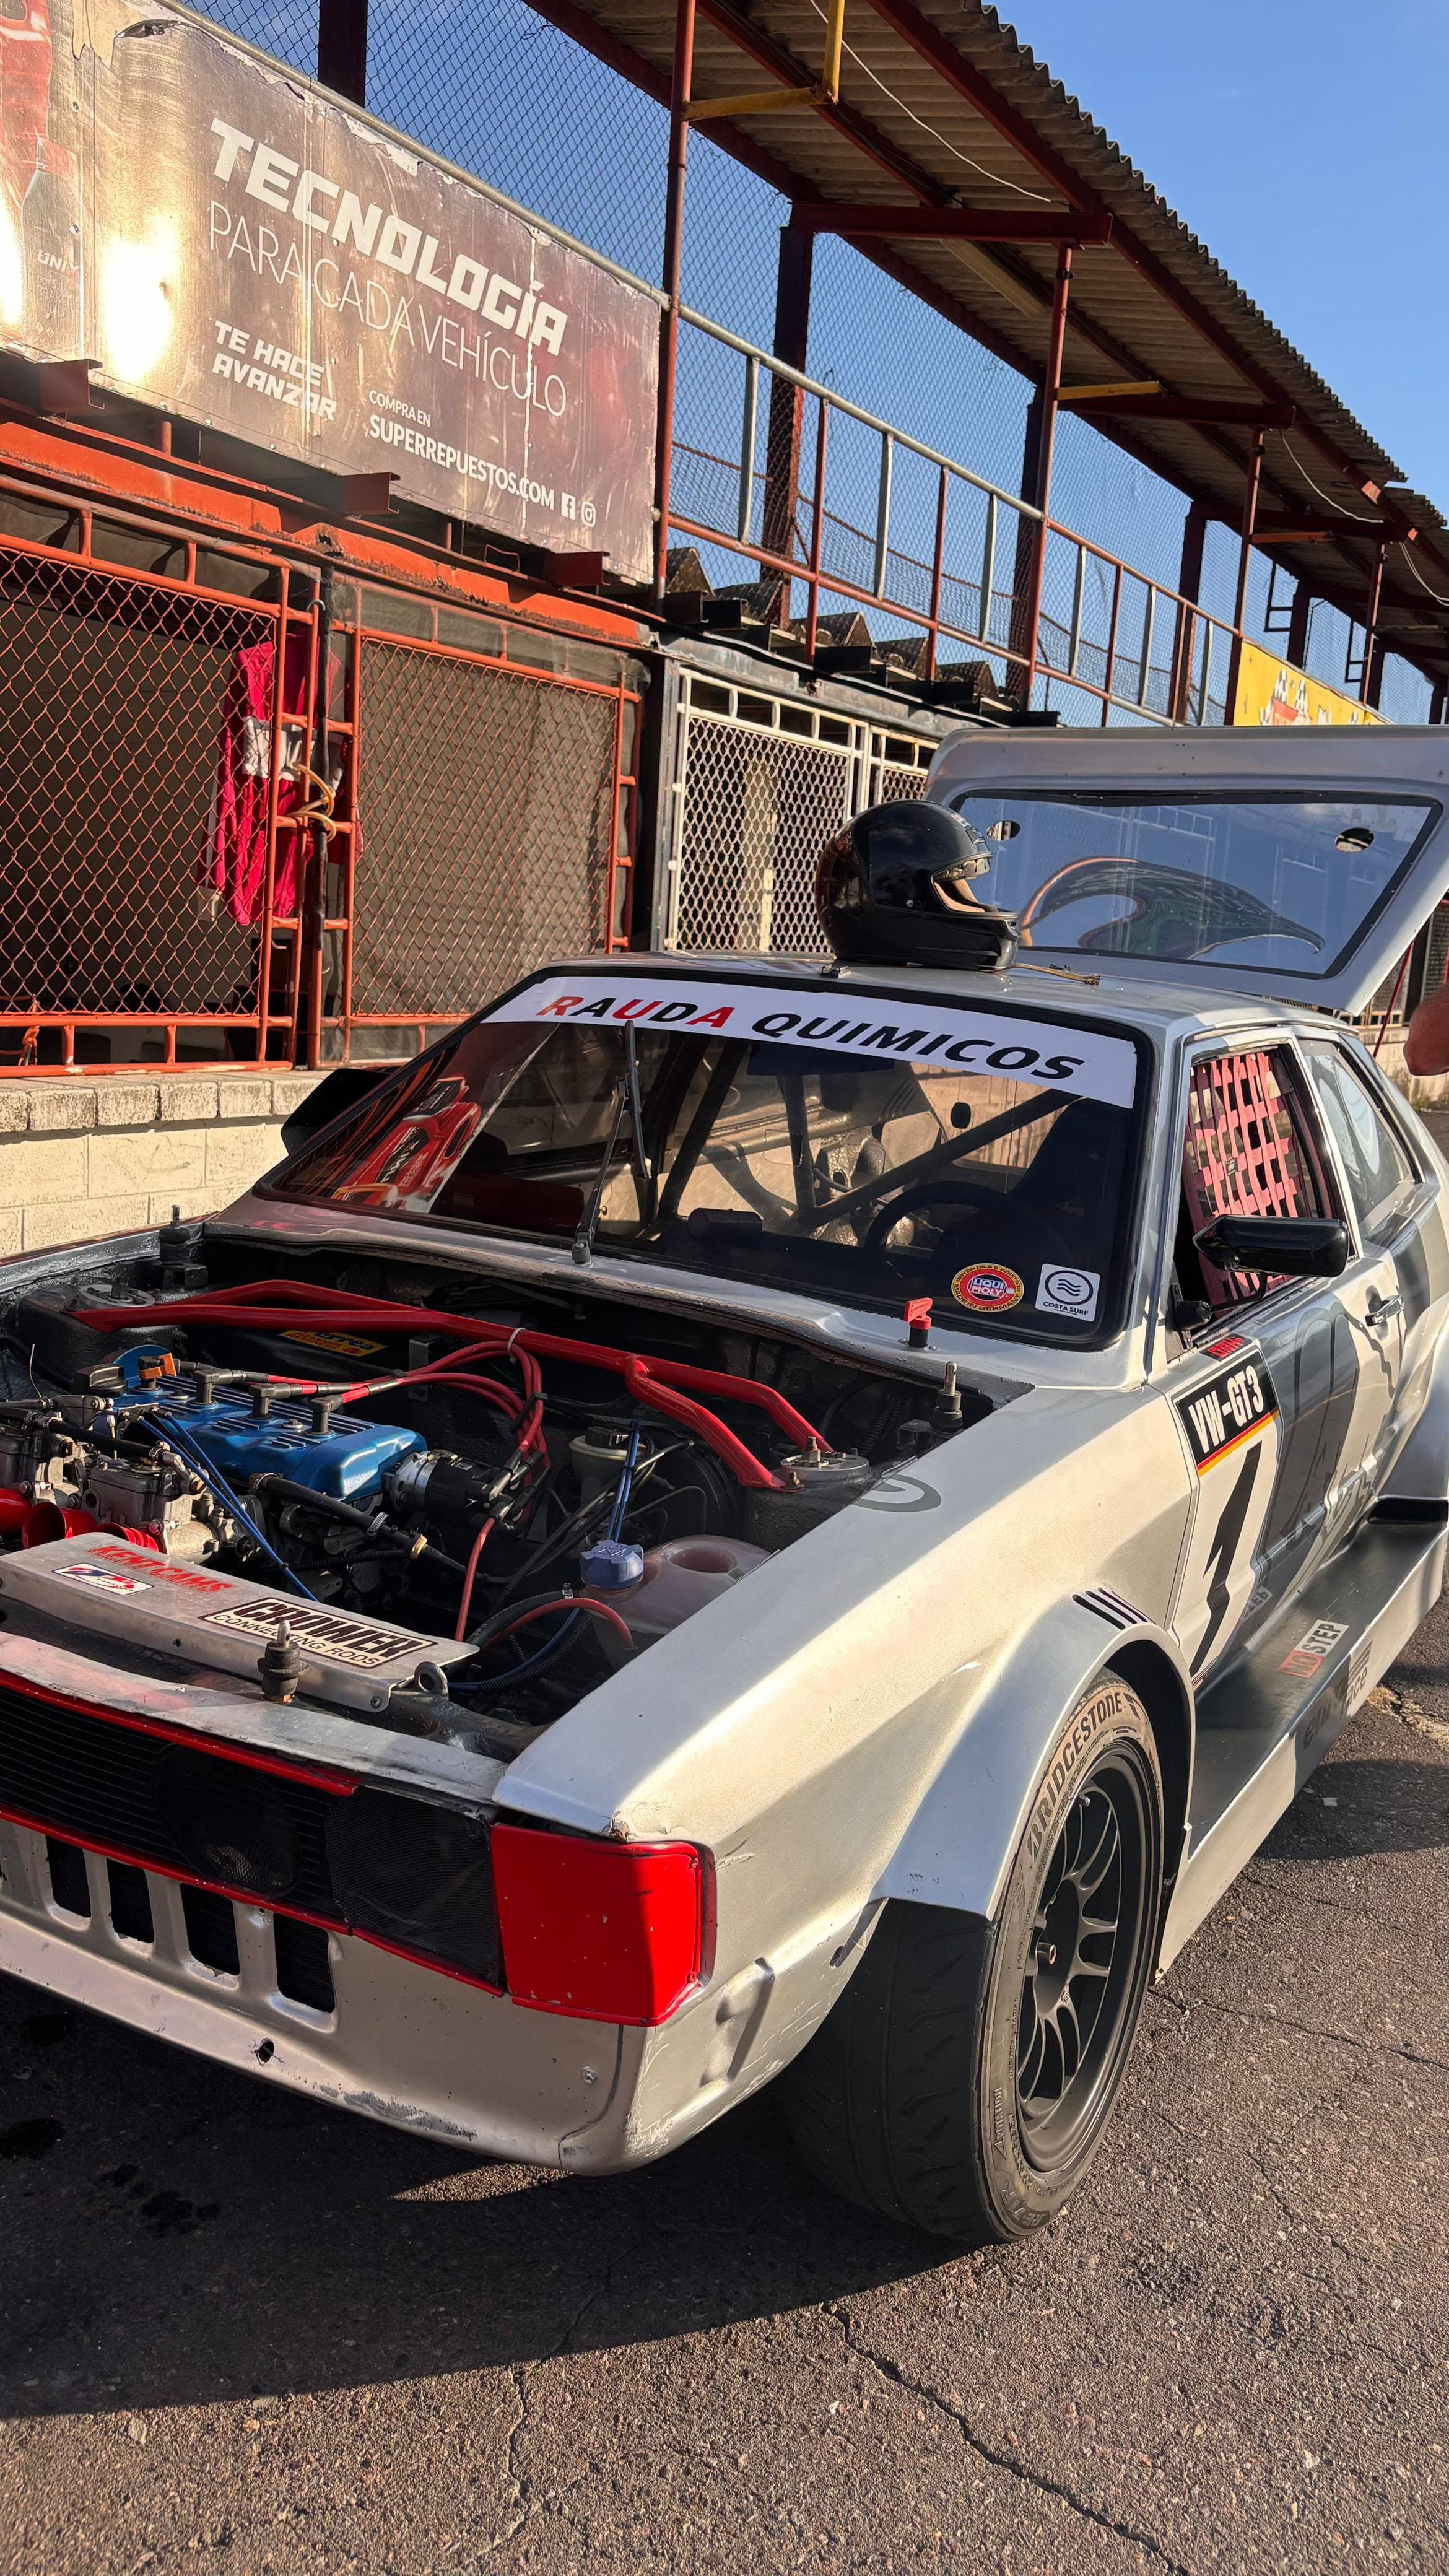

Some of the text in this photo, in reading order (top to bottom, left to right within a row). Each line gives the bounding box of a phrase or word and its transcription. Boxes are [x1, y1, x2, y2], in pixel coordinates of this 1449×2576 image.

[210, 117, 568, 357] TECNOLOGÍA
[210, 200, 567, 417] PARA CADA VEHÍCULO
[215, 320, 325, 387] TE HACE
[212, 352, 337, 421] AVANZAR
[369, 389, 431, 427] COMPRA EN
[369, 414, 554, 511] SUPERREPUESTOS.COM
[536, 996, 1086, 1080] RAUDA QUIMICOS
[954, 1284, 1020, 1312] MADE IN GERMANY
[971, 1285, 1003, 1297] MOLY
[973, 1278, 1004, 1289] LIQUI
[1043, 1302, 1068, 1311] COSTA
[1069, 1307, 1089, 1316] SURF
[1188, 1365, 1264, 1454] VW-GT3
[84, 1545, 168, 1570] KENT
[147, 1567, 233, 1593] CAMS
[233, 1602, 424, 1658] CROWER
[325, 1647, 380, 1664] RODS
[1279, 1654, 1319, 1676] NO
[1302, 1622, 1342, 1655] STEP
[1026, 1692, 1123, 1863] BRIDGESTONE
